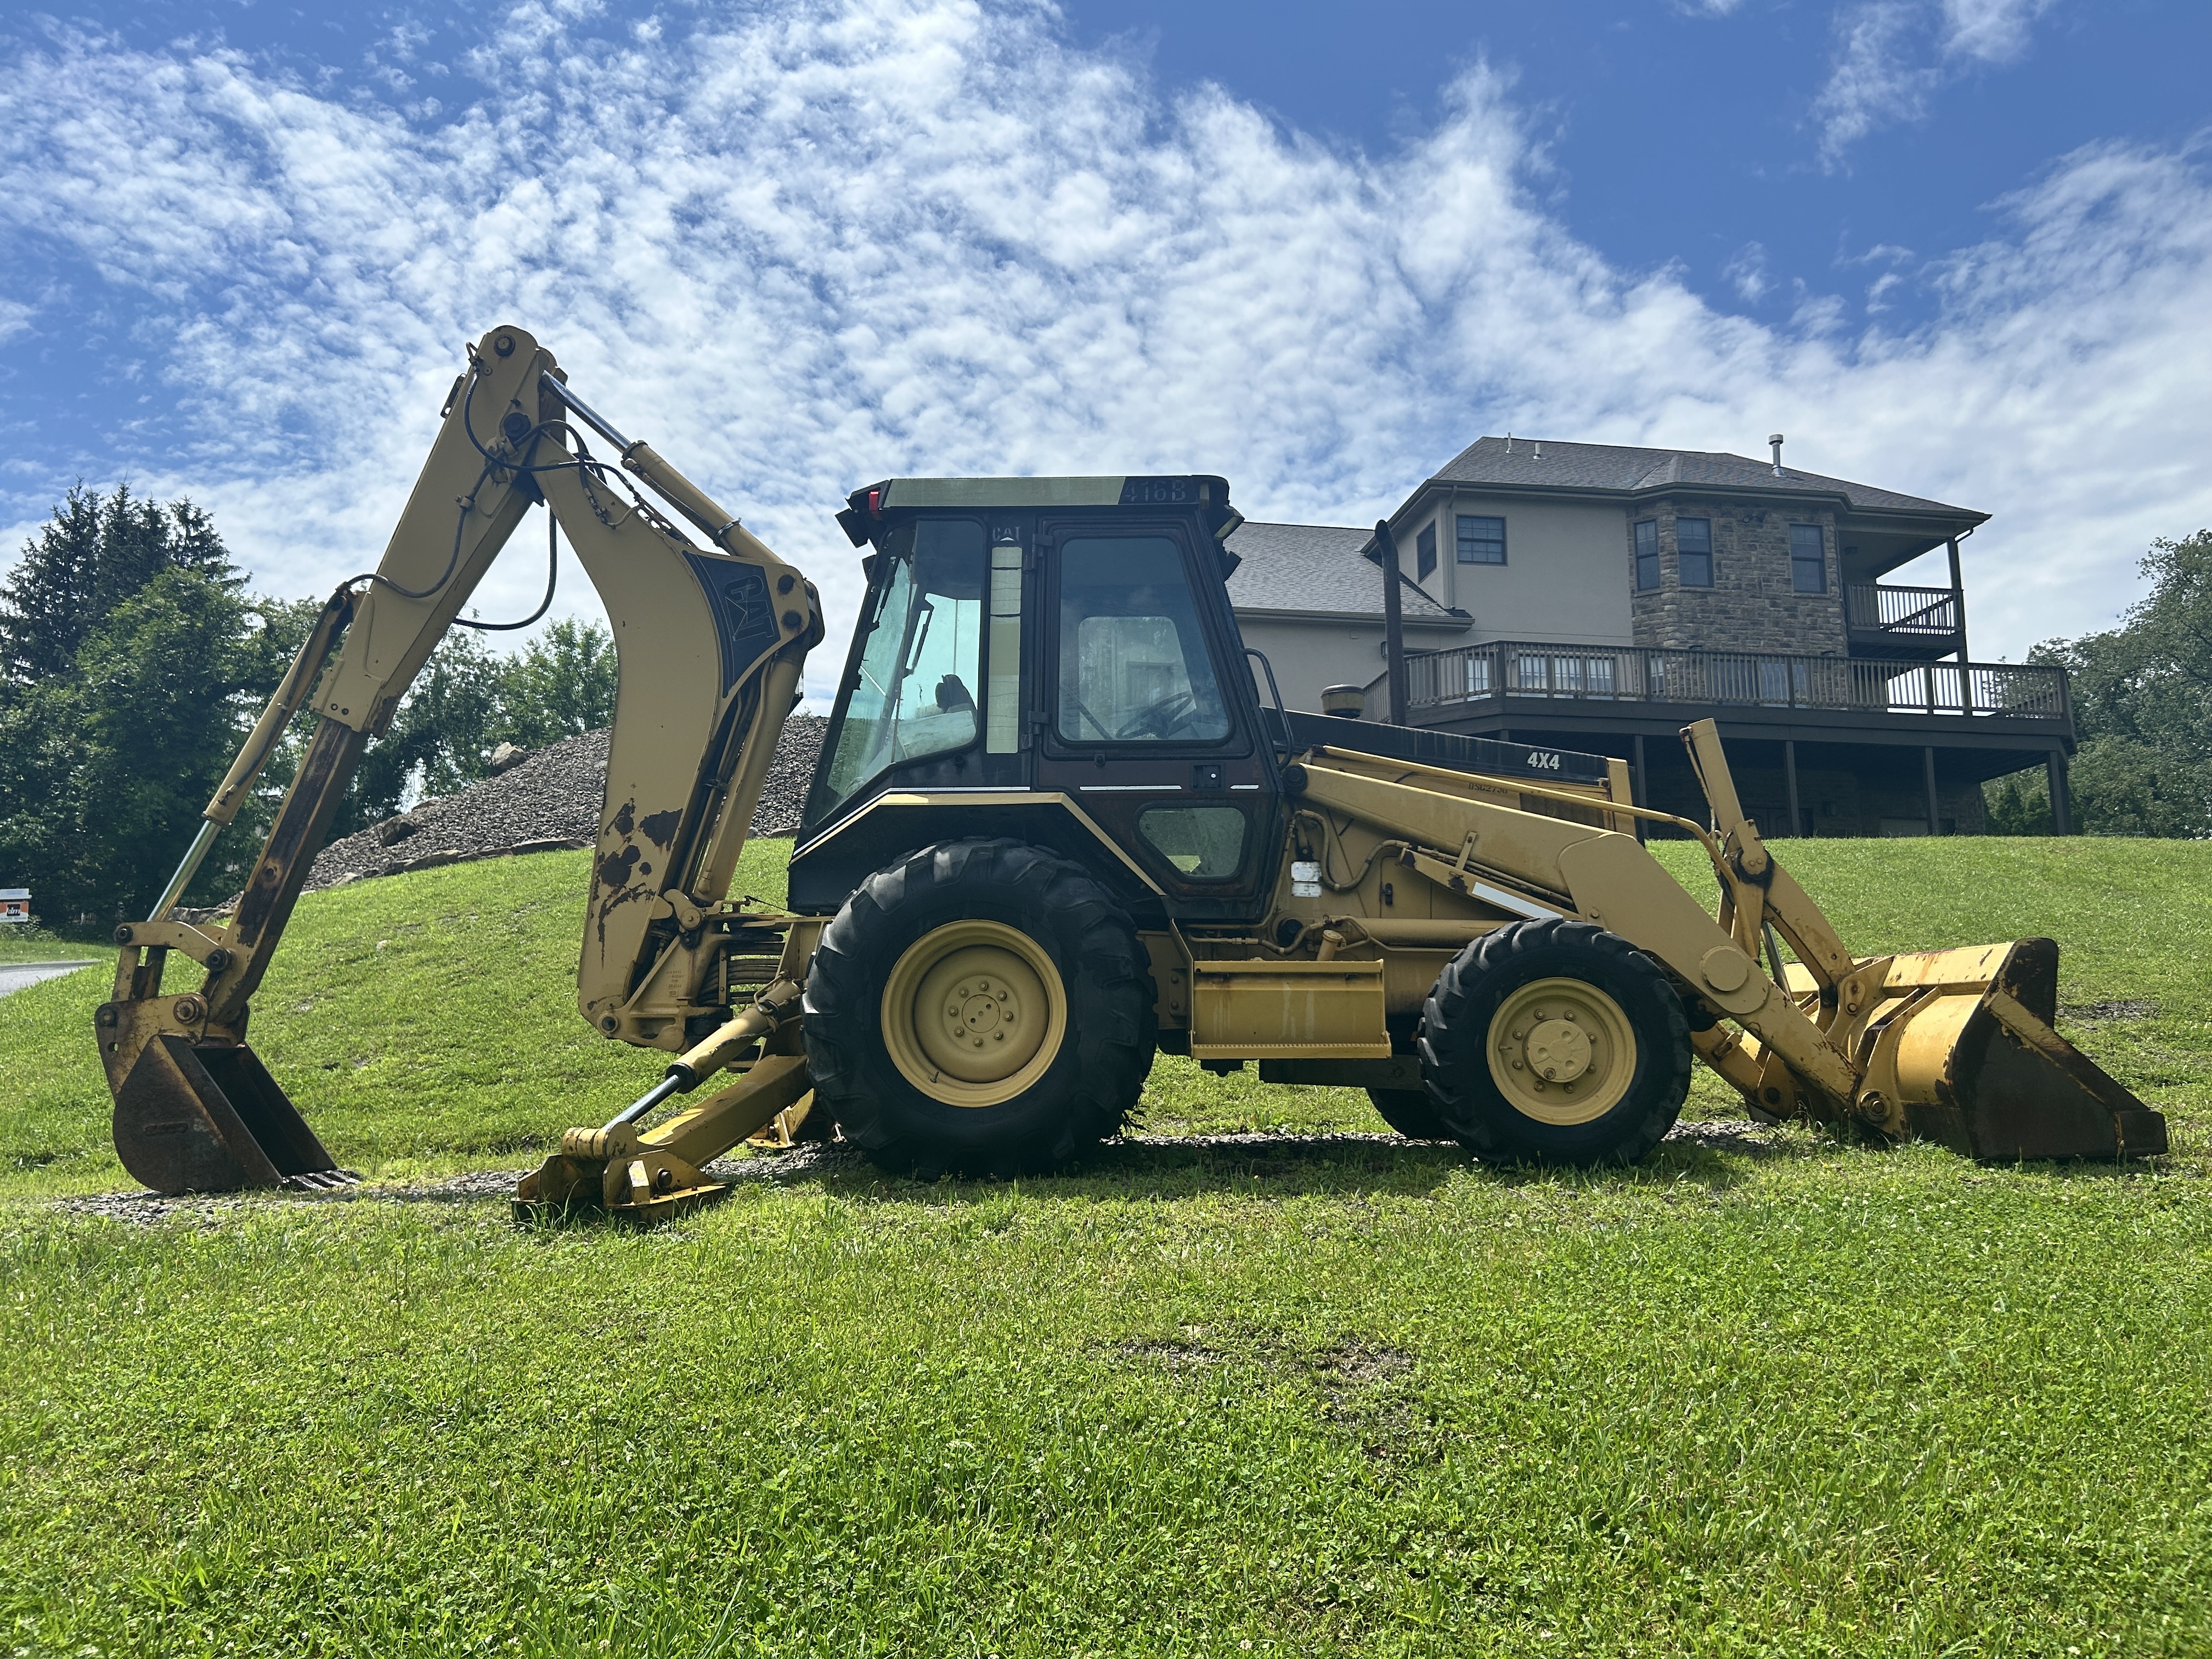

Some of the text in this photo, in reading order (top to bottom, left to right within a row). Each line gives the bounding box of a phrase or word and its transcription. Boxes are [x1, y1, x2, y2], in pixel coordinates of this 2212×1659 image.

[1124, 479, 1186, 501] 416B
[992, 526, 1020, 541] CAT
[724, 575, 775, 642] CAT
[1527, 752, 1560, 770] 4X4
